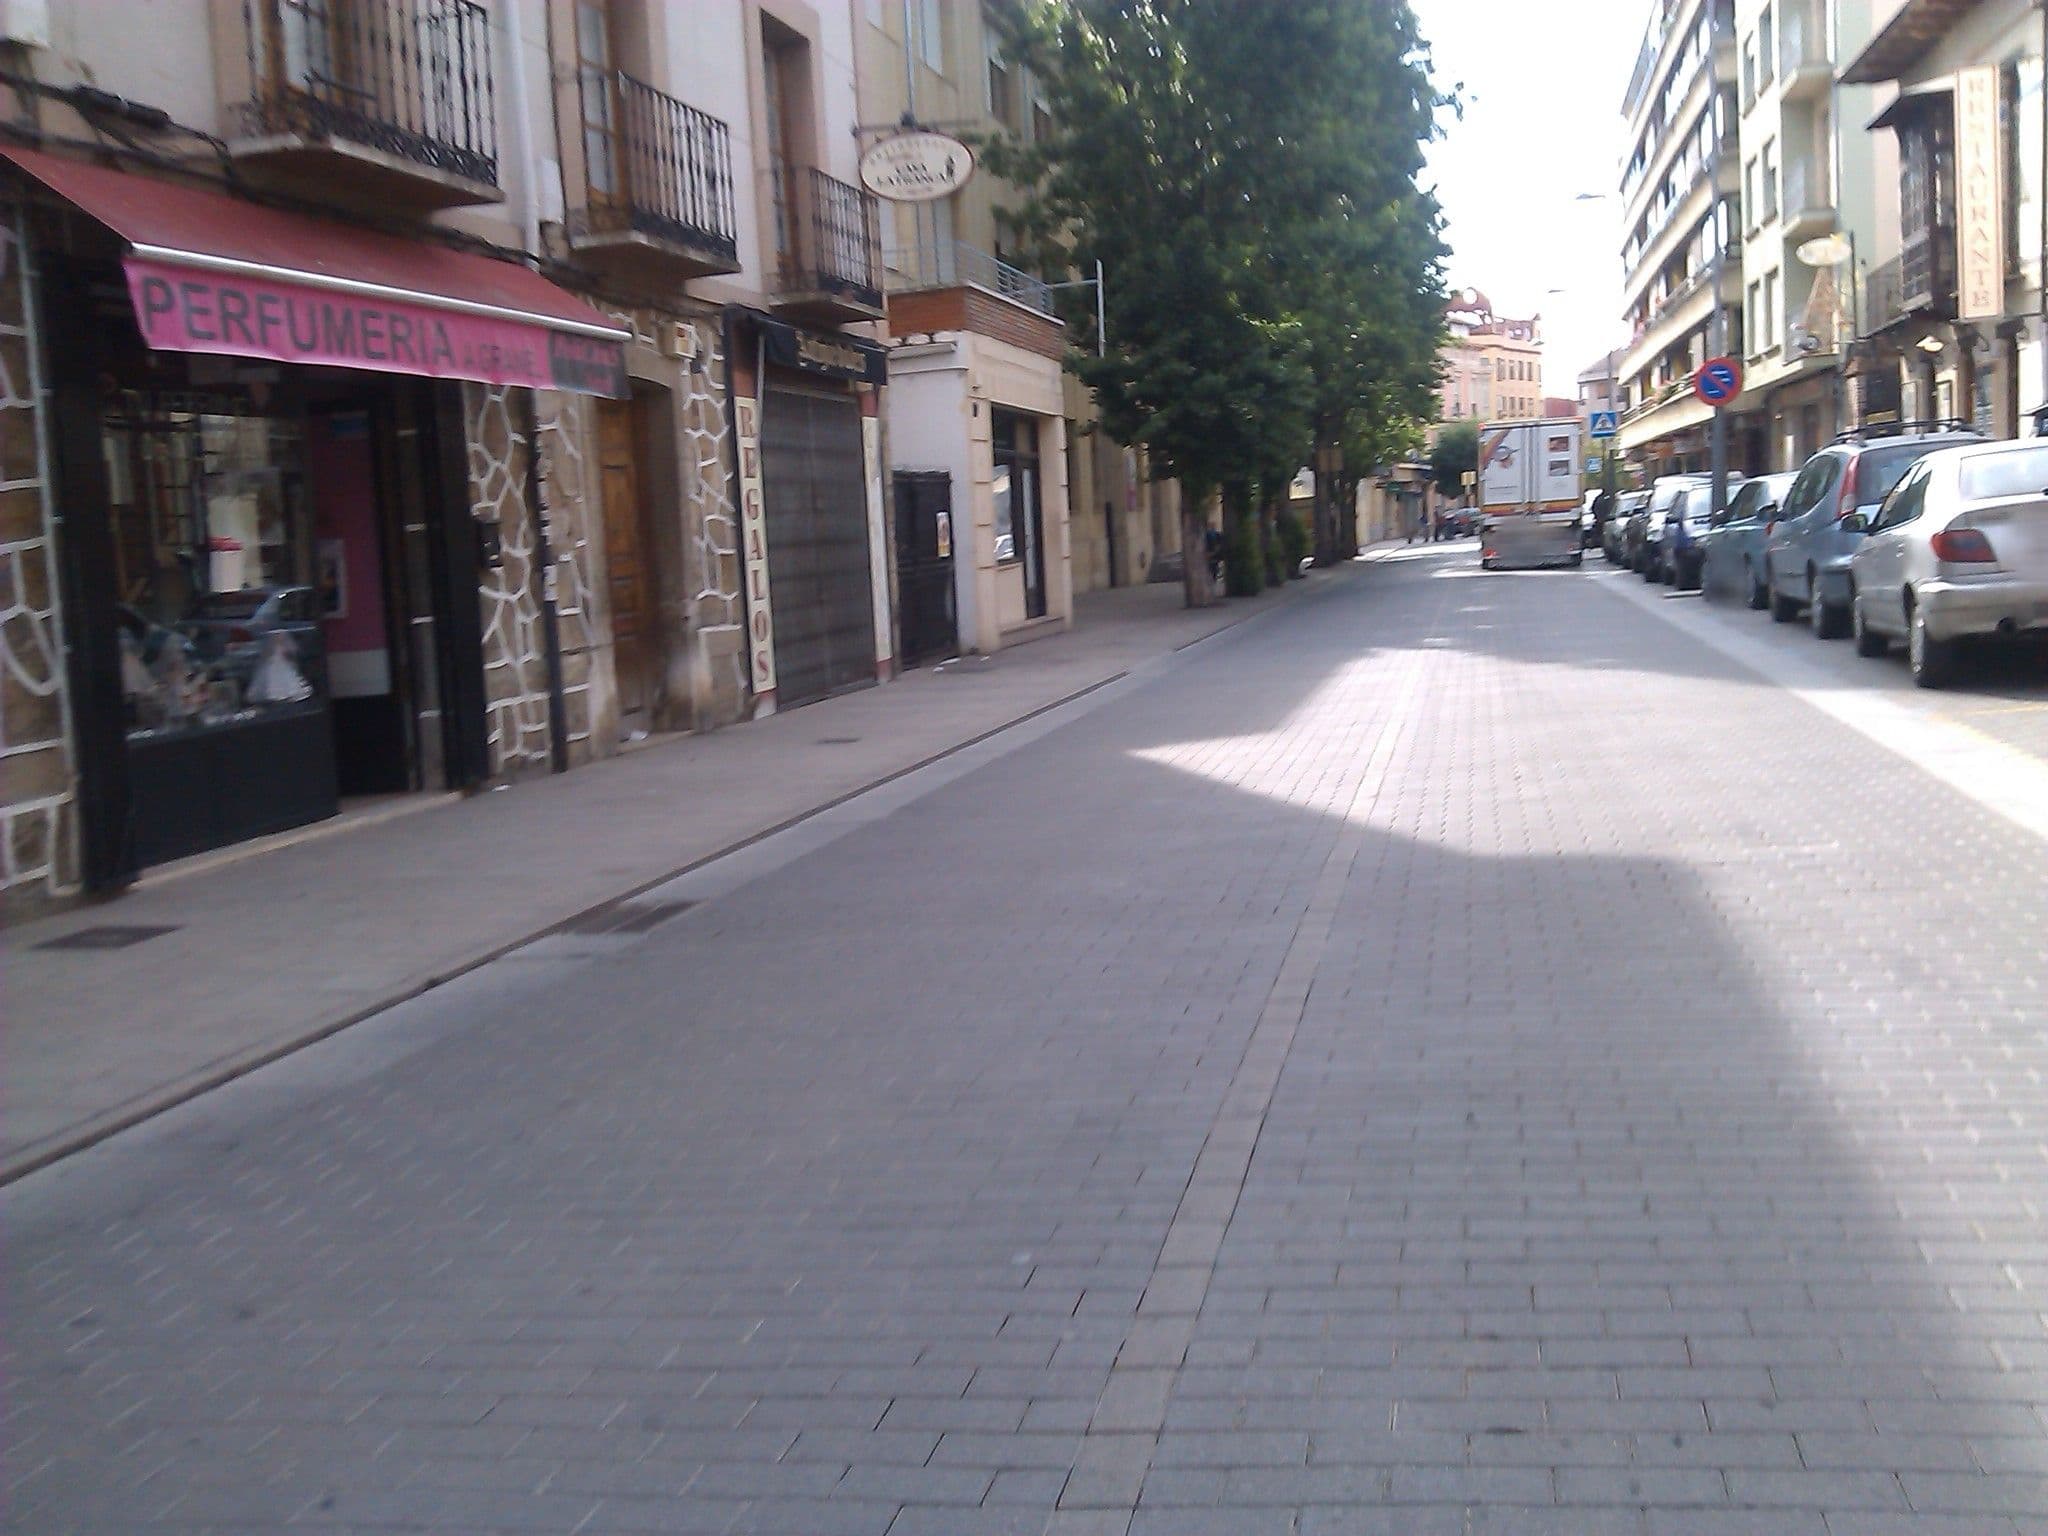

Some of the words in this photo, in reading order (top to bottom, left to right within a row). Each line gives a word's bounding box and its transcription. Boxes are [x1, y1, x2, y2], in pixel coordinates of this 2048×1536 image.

[1967, 77, 1990, 307] RESTAURANTE
[140, 277, 457, 363] PERFUMERIA
[738, 406, 769, 682] REGALOS
